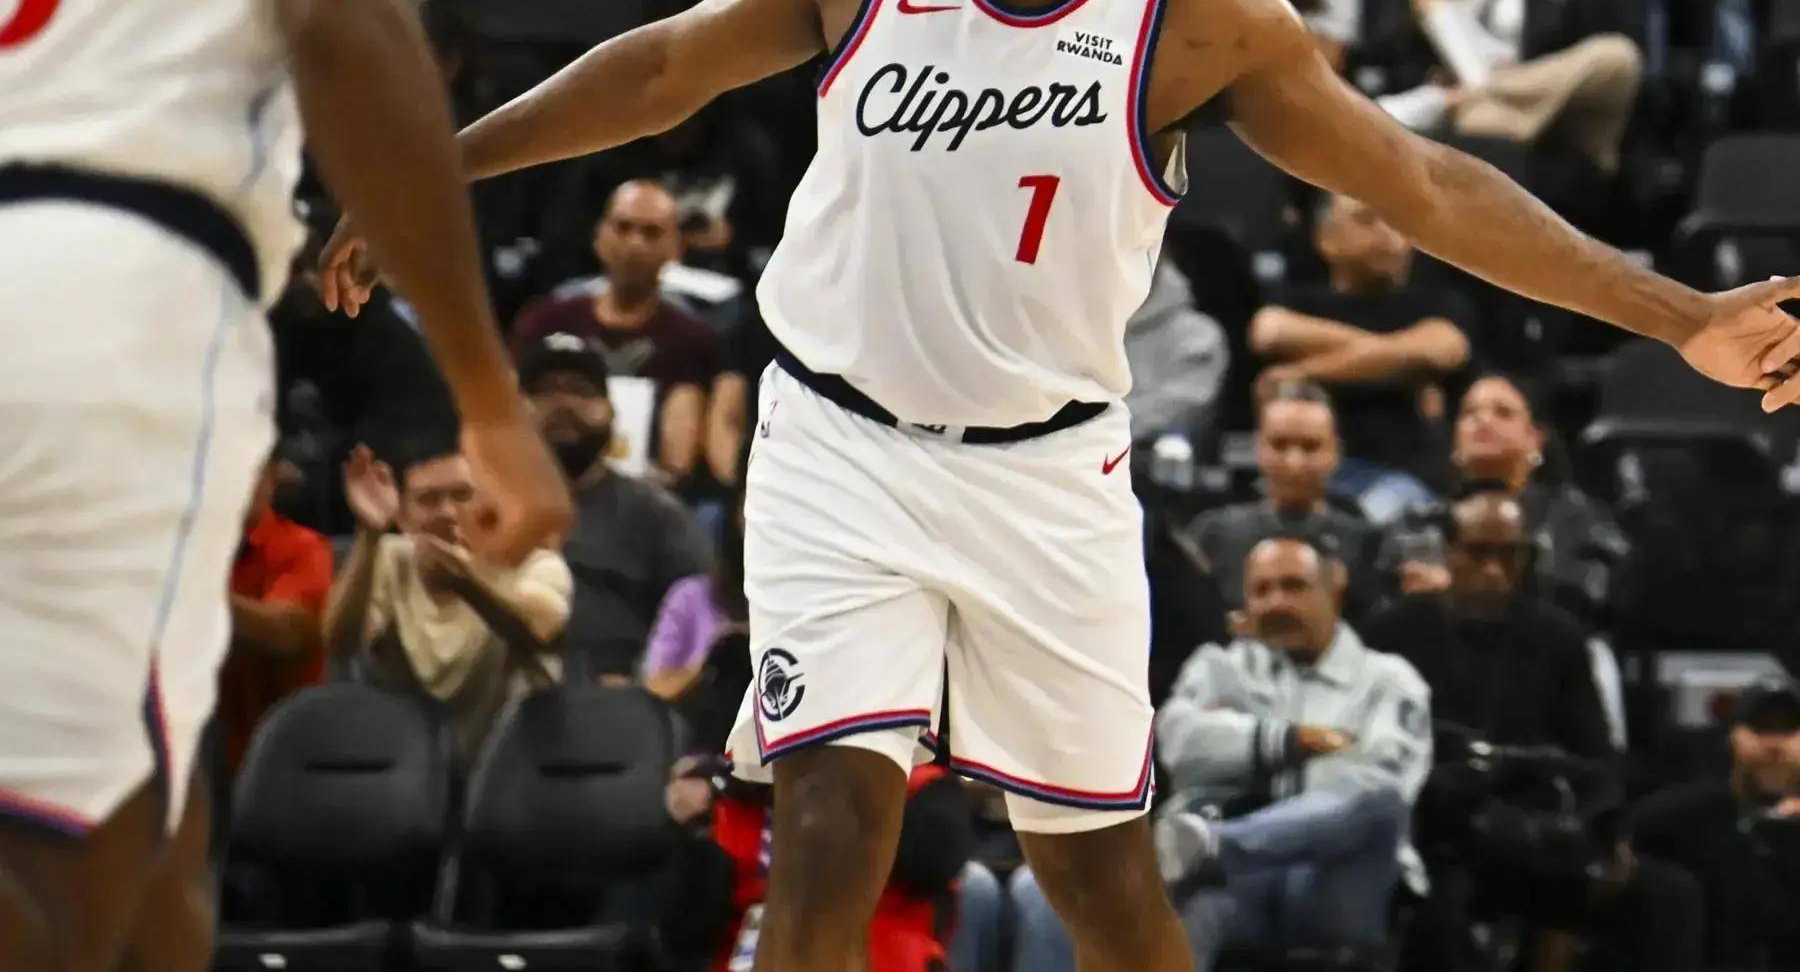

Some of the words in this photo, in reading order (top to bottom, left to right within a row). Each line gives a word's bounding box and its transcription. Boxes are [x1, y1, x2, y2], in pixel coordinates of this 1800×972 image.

[1057, 40, 1123, 66] RWANDA
[1075, 31, 1113, 50] VISIT
[856, 62, 1108, 152] Clippers
[1015, 174, 1060, 265] 1
